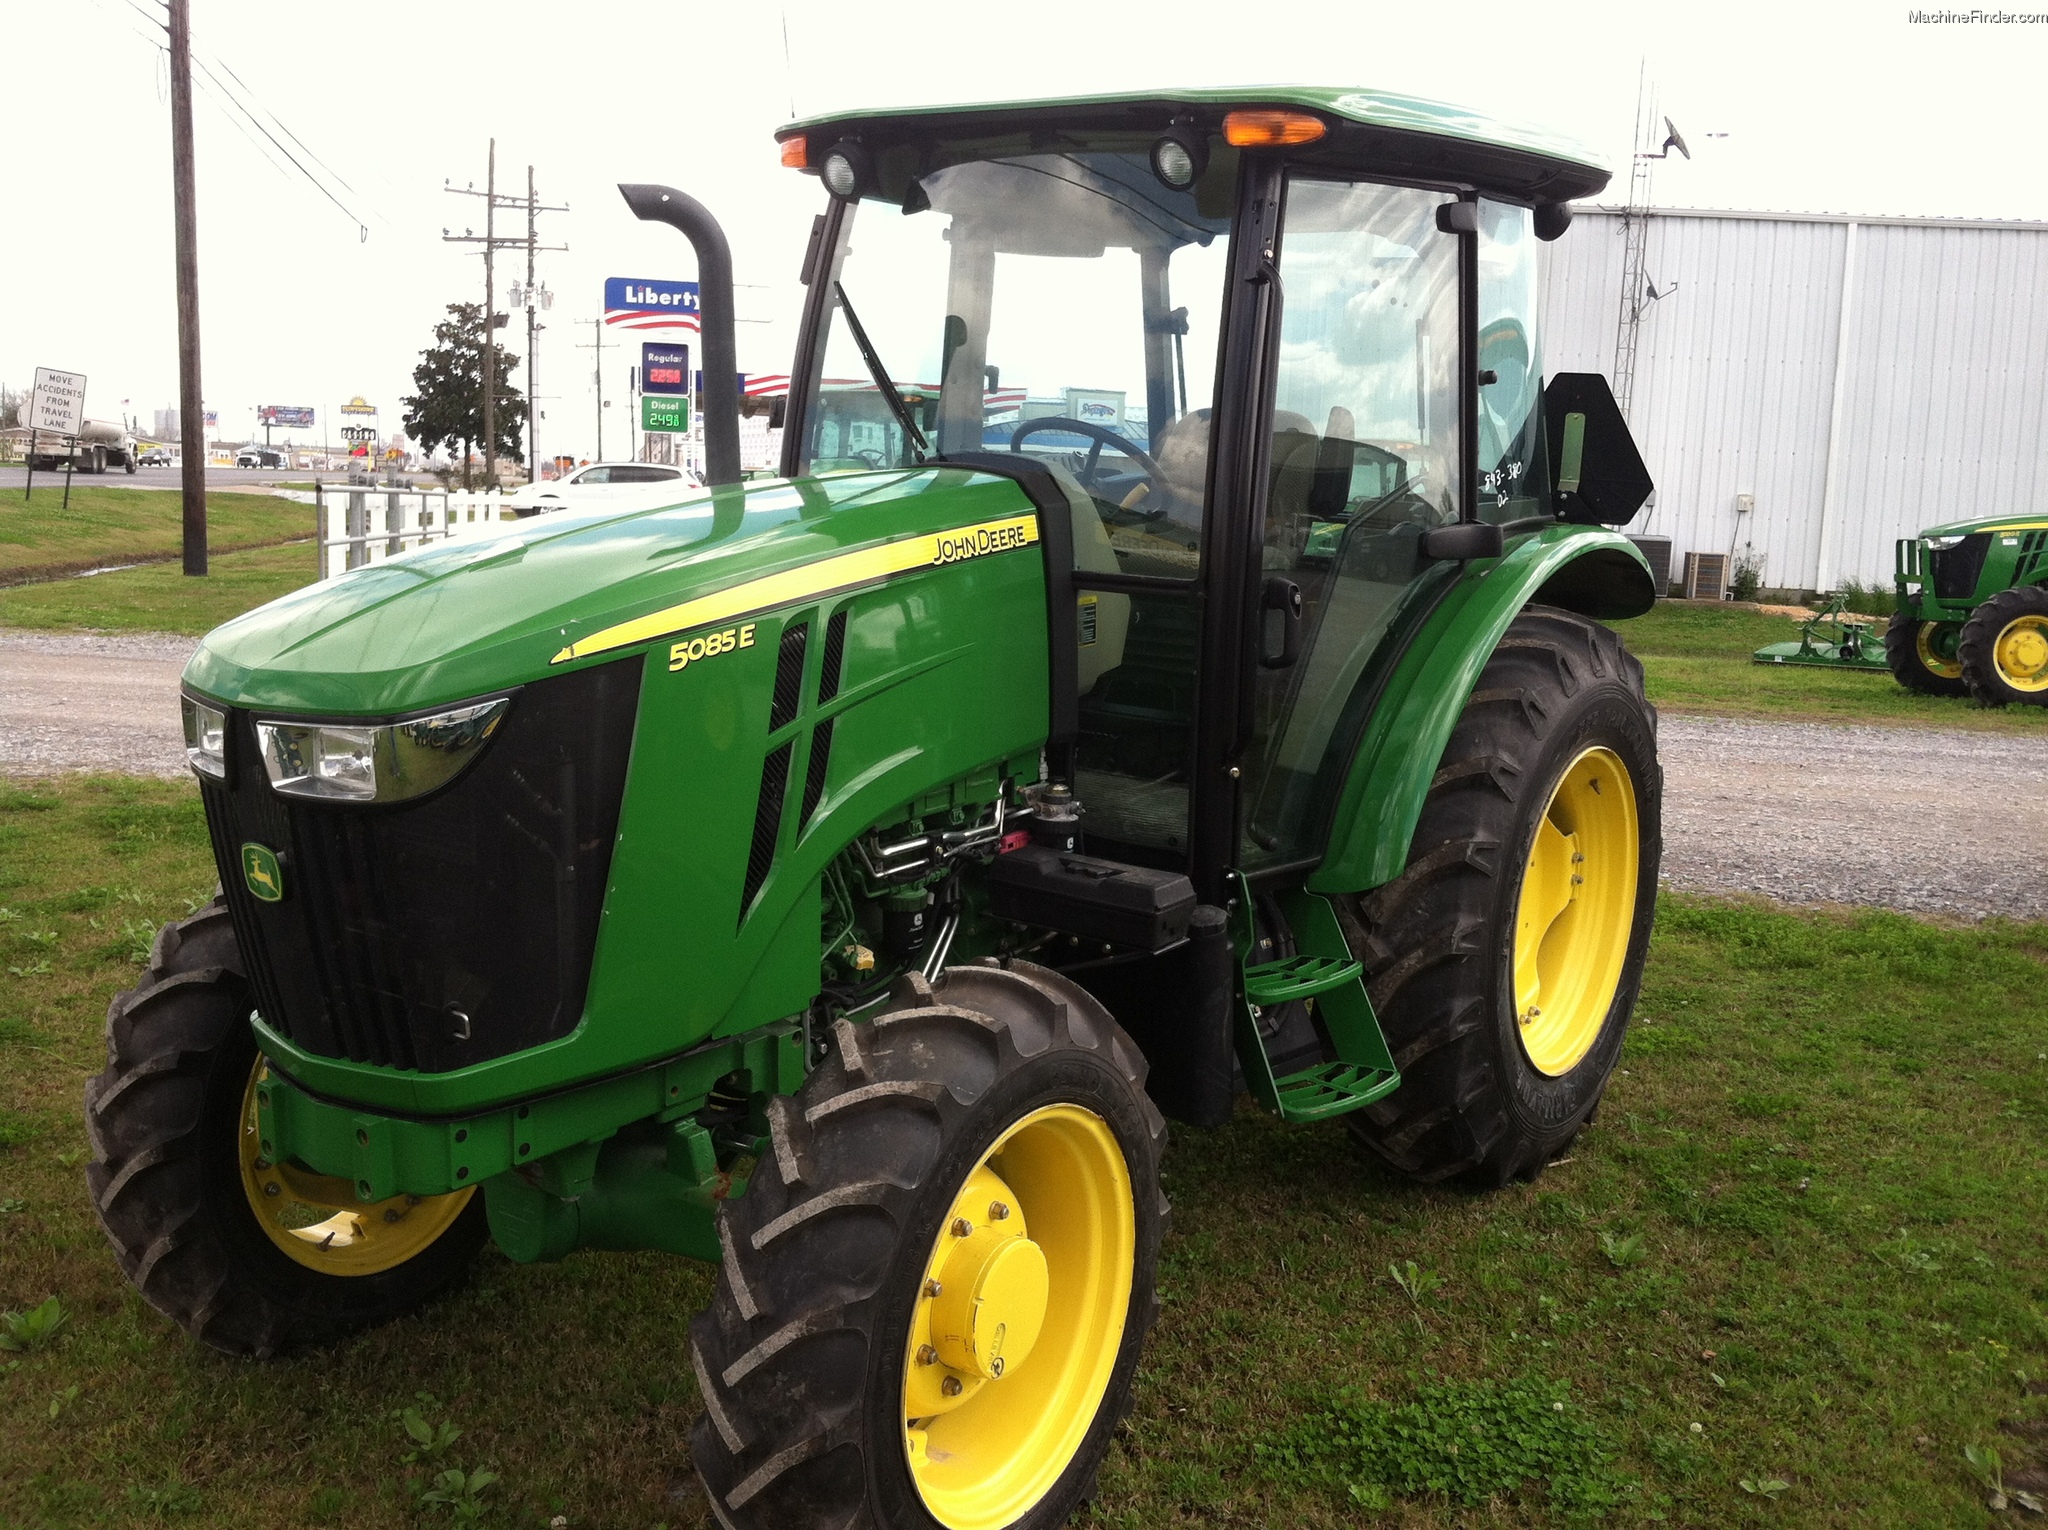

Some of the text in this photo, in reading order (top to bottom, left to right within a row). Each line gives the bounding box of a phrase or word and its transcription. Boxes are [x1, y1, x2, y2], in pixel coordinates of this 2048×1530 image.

[648, 353, 683, 364] Regular
[49, 374, 73, 386] MOVE
[37, 383, 82, 399] ACCIDENTS
[46, 396, 70, 407] FROM
[651, 401, 680, 410] Diesel
[41, 406, 73, 419] TRAVEL
[44, 418, 67, 430] LANE
[342, 430, 374, 439] CASINO
